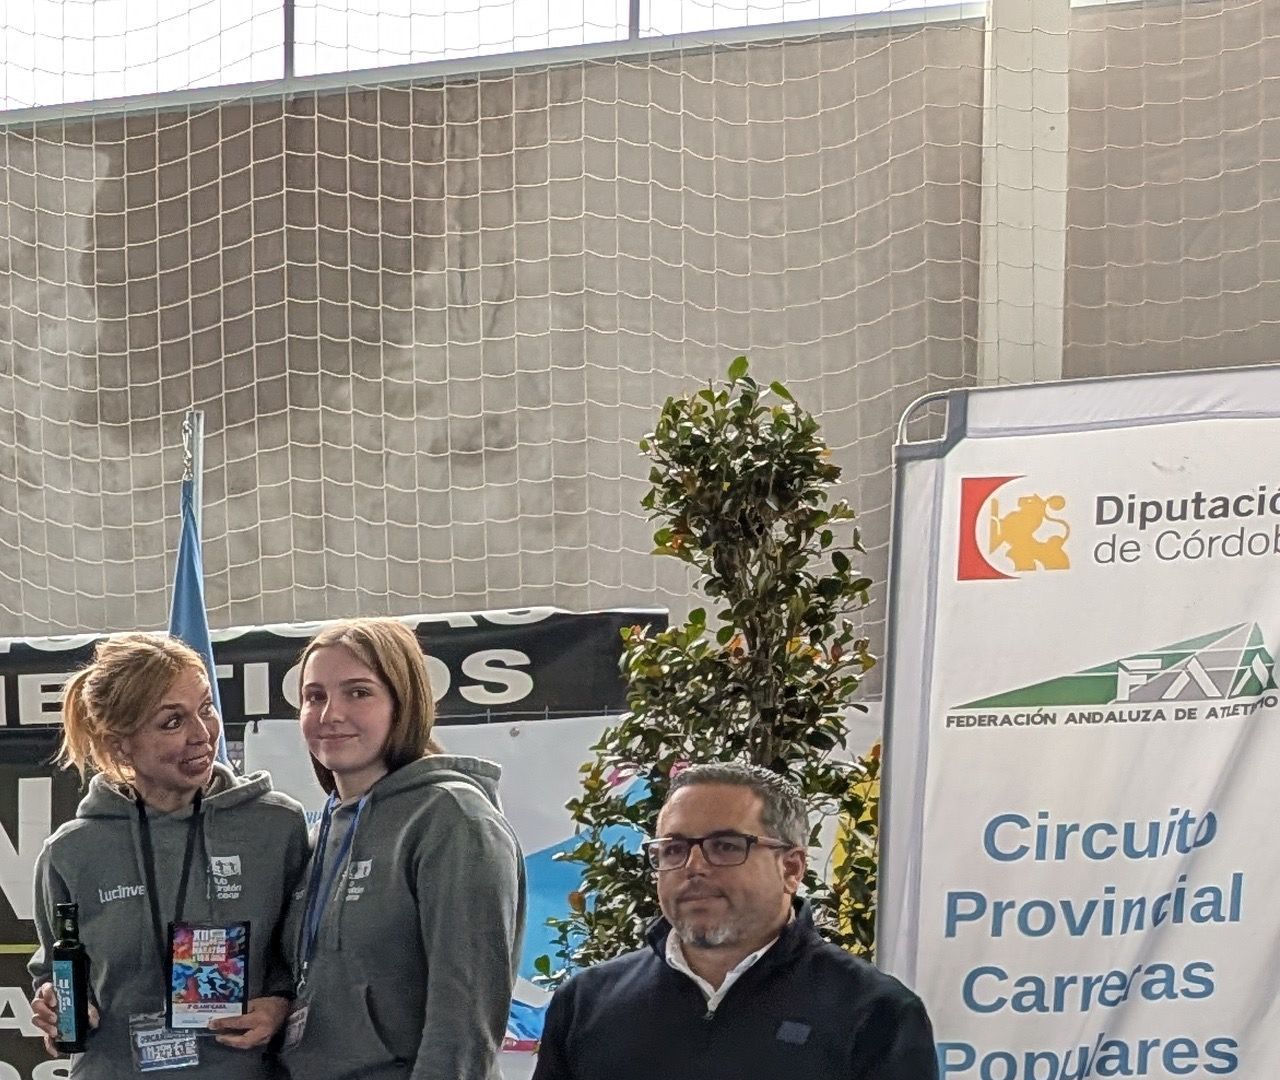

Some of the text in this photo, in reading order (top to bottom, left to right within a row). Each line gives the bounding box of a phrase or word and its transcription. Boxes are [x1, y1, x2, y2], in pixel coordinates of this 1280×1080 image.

[1093, 534, 1141, 564] de
[945, 708, 1057, 729] FEDERACIÓN
[1064, 708, 1165, 726] ANDALUZA
[1174, 708, 1198, 722] DE
[983, 807, 1218, 863] Circuito
[944, 872, 1244, 938] Provincial
[962, 961, 1215, 1014] Carreras
